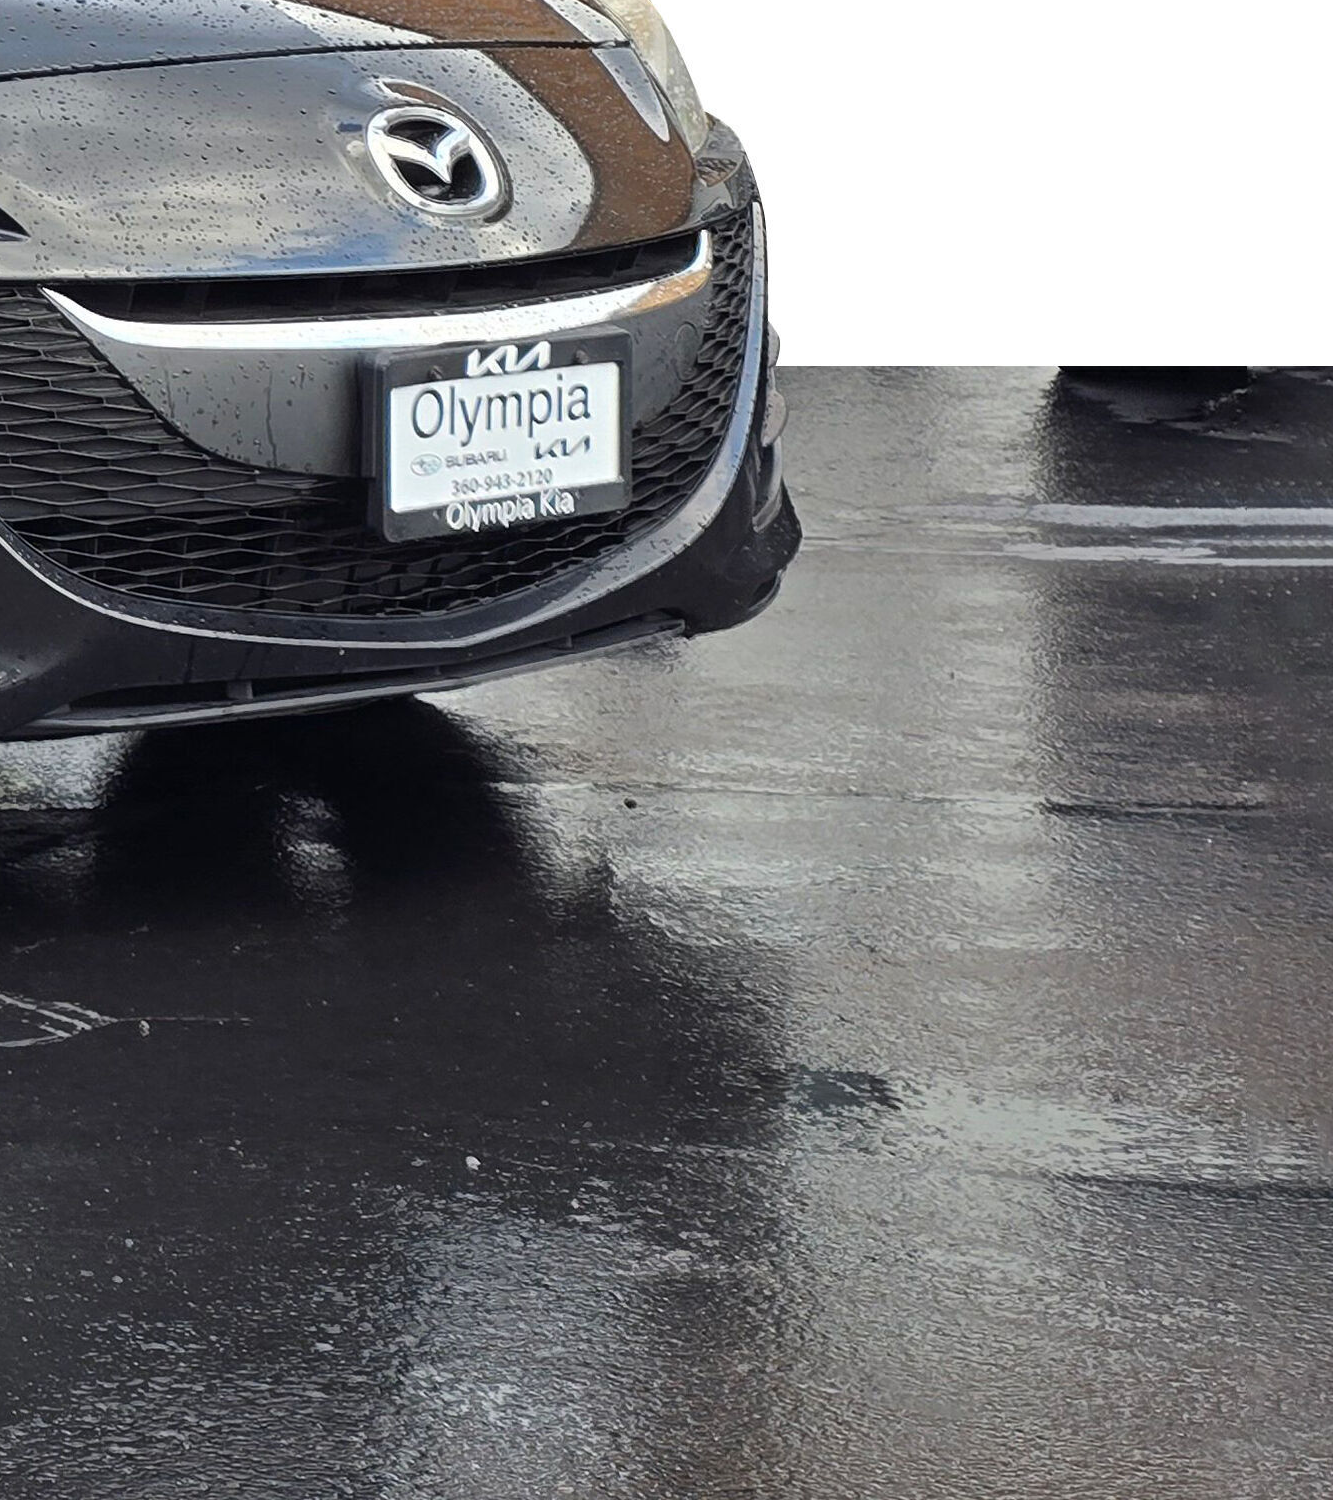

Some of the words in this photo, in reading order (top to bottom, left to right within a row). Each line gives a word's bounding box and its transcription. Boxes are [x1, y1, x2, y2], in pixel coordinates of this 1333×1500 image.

[465, 341, 551, 376] KIA
[412, 373, 591, 447] Olympia
[444, 448, 508, 468] SUBARU
[534, 436, 591, 460] KIA
[450, 467, 553, 496] 360-943-2120
[446, 494, 535, 532] Olympia
[539, 488, 575, 516] Kia
